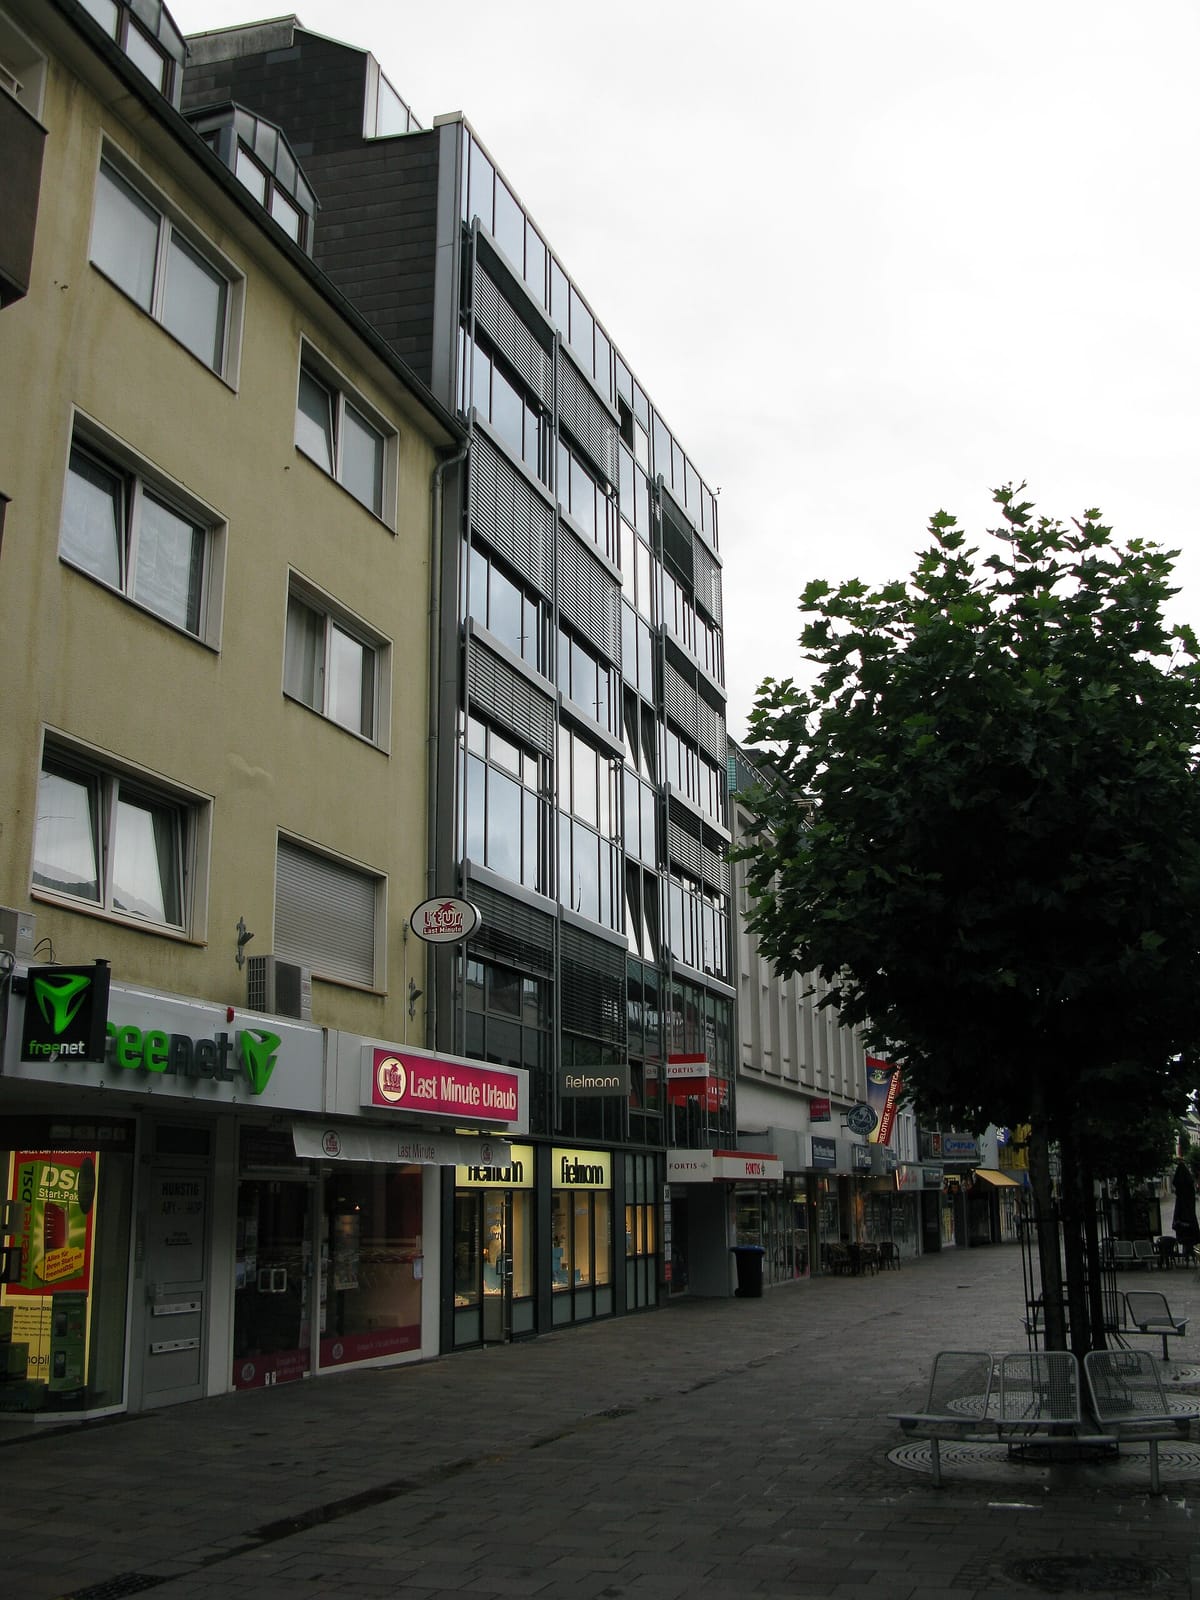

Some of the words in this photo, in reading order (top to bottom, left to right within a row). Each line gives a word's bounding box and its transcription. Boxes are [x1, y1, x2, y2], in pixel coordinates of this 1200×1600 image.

[29, 1040, 85, 1056] freenet
[105, 1021, 234, 1082] eenet
[566, 1075, 620, 1089] fielmann
[411, 1070, 438, 1099] Last
[441, 1075, 480, 1106] Minute
[482, 1082, 517, 1111] Urlaub
[397, 1143, 412, 1157] Last
[413, 1144, 435, 1160] Minute
[561, 1156, 604, 1185] fielmann
[669, 1162, 698, 1170] FORTIS
[745, 1162, 761, 1175] FORTIS
[39, 1188, 79, 1201] Start-Pak
